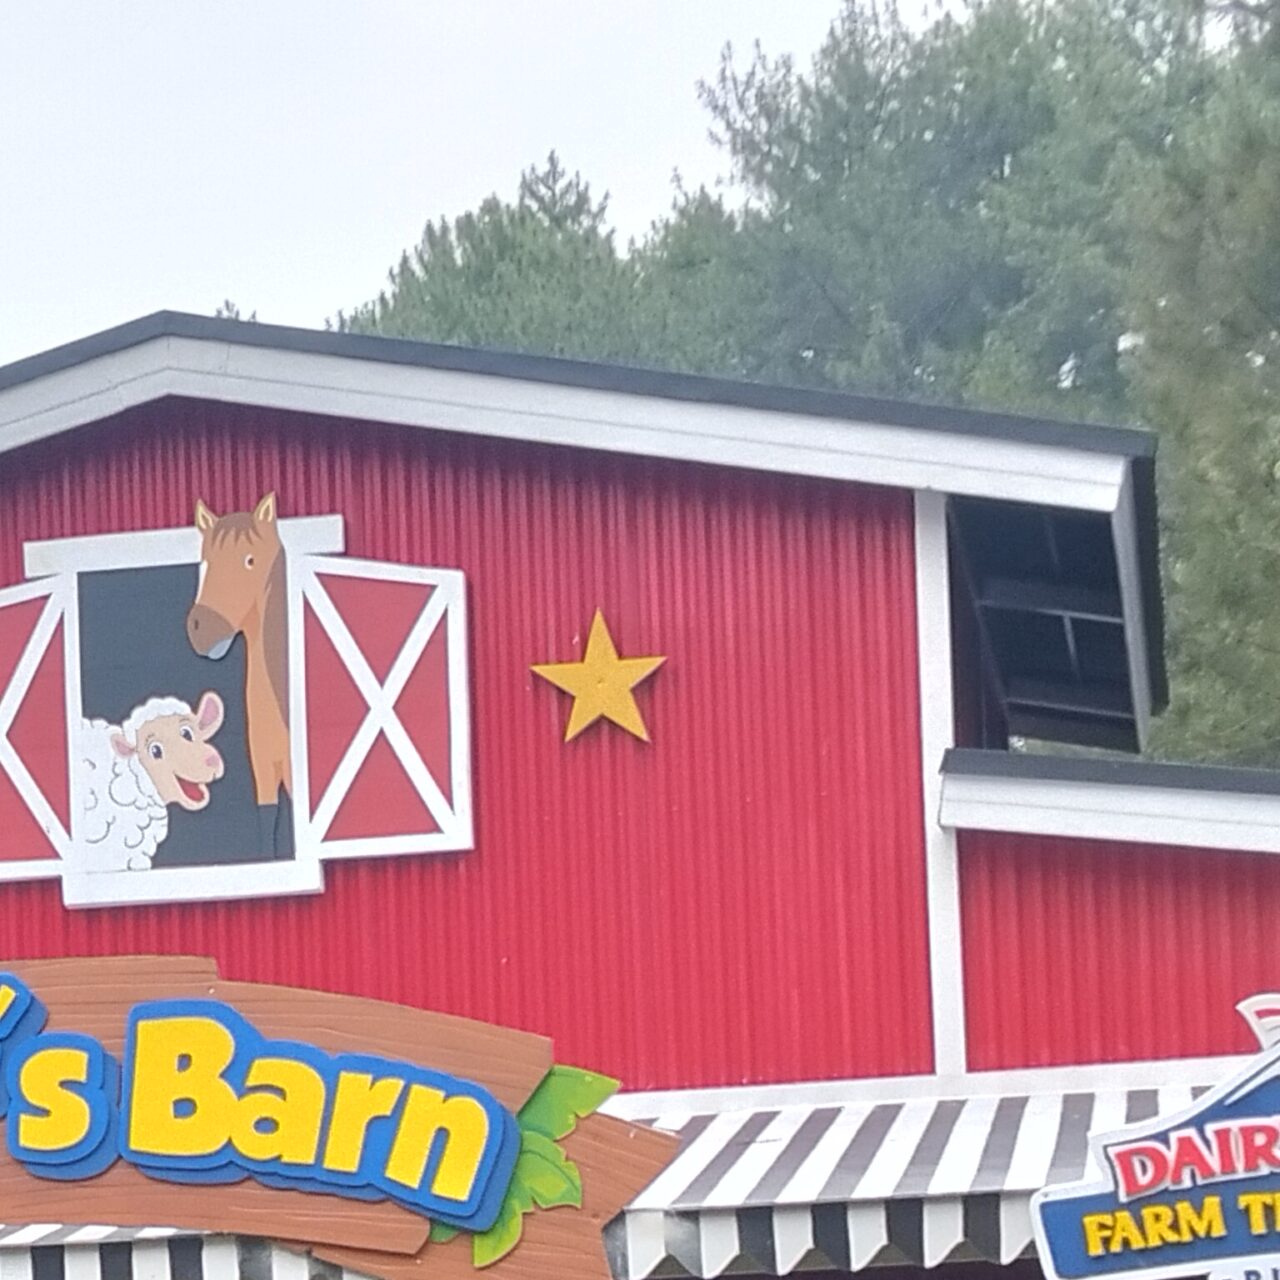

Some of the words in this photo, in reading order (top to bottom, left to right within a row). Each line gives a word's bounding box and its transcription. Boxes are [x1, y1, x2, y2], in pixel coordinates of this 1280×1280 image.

[128, 1016, 490, 1202] Barn
[1083, 1196, 1227, 1257] FARM
[1237, 1191, 1280, 1236] T
